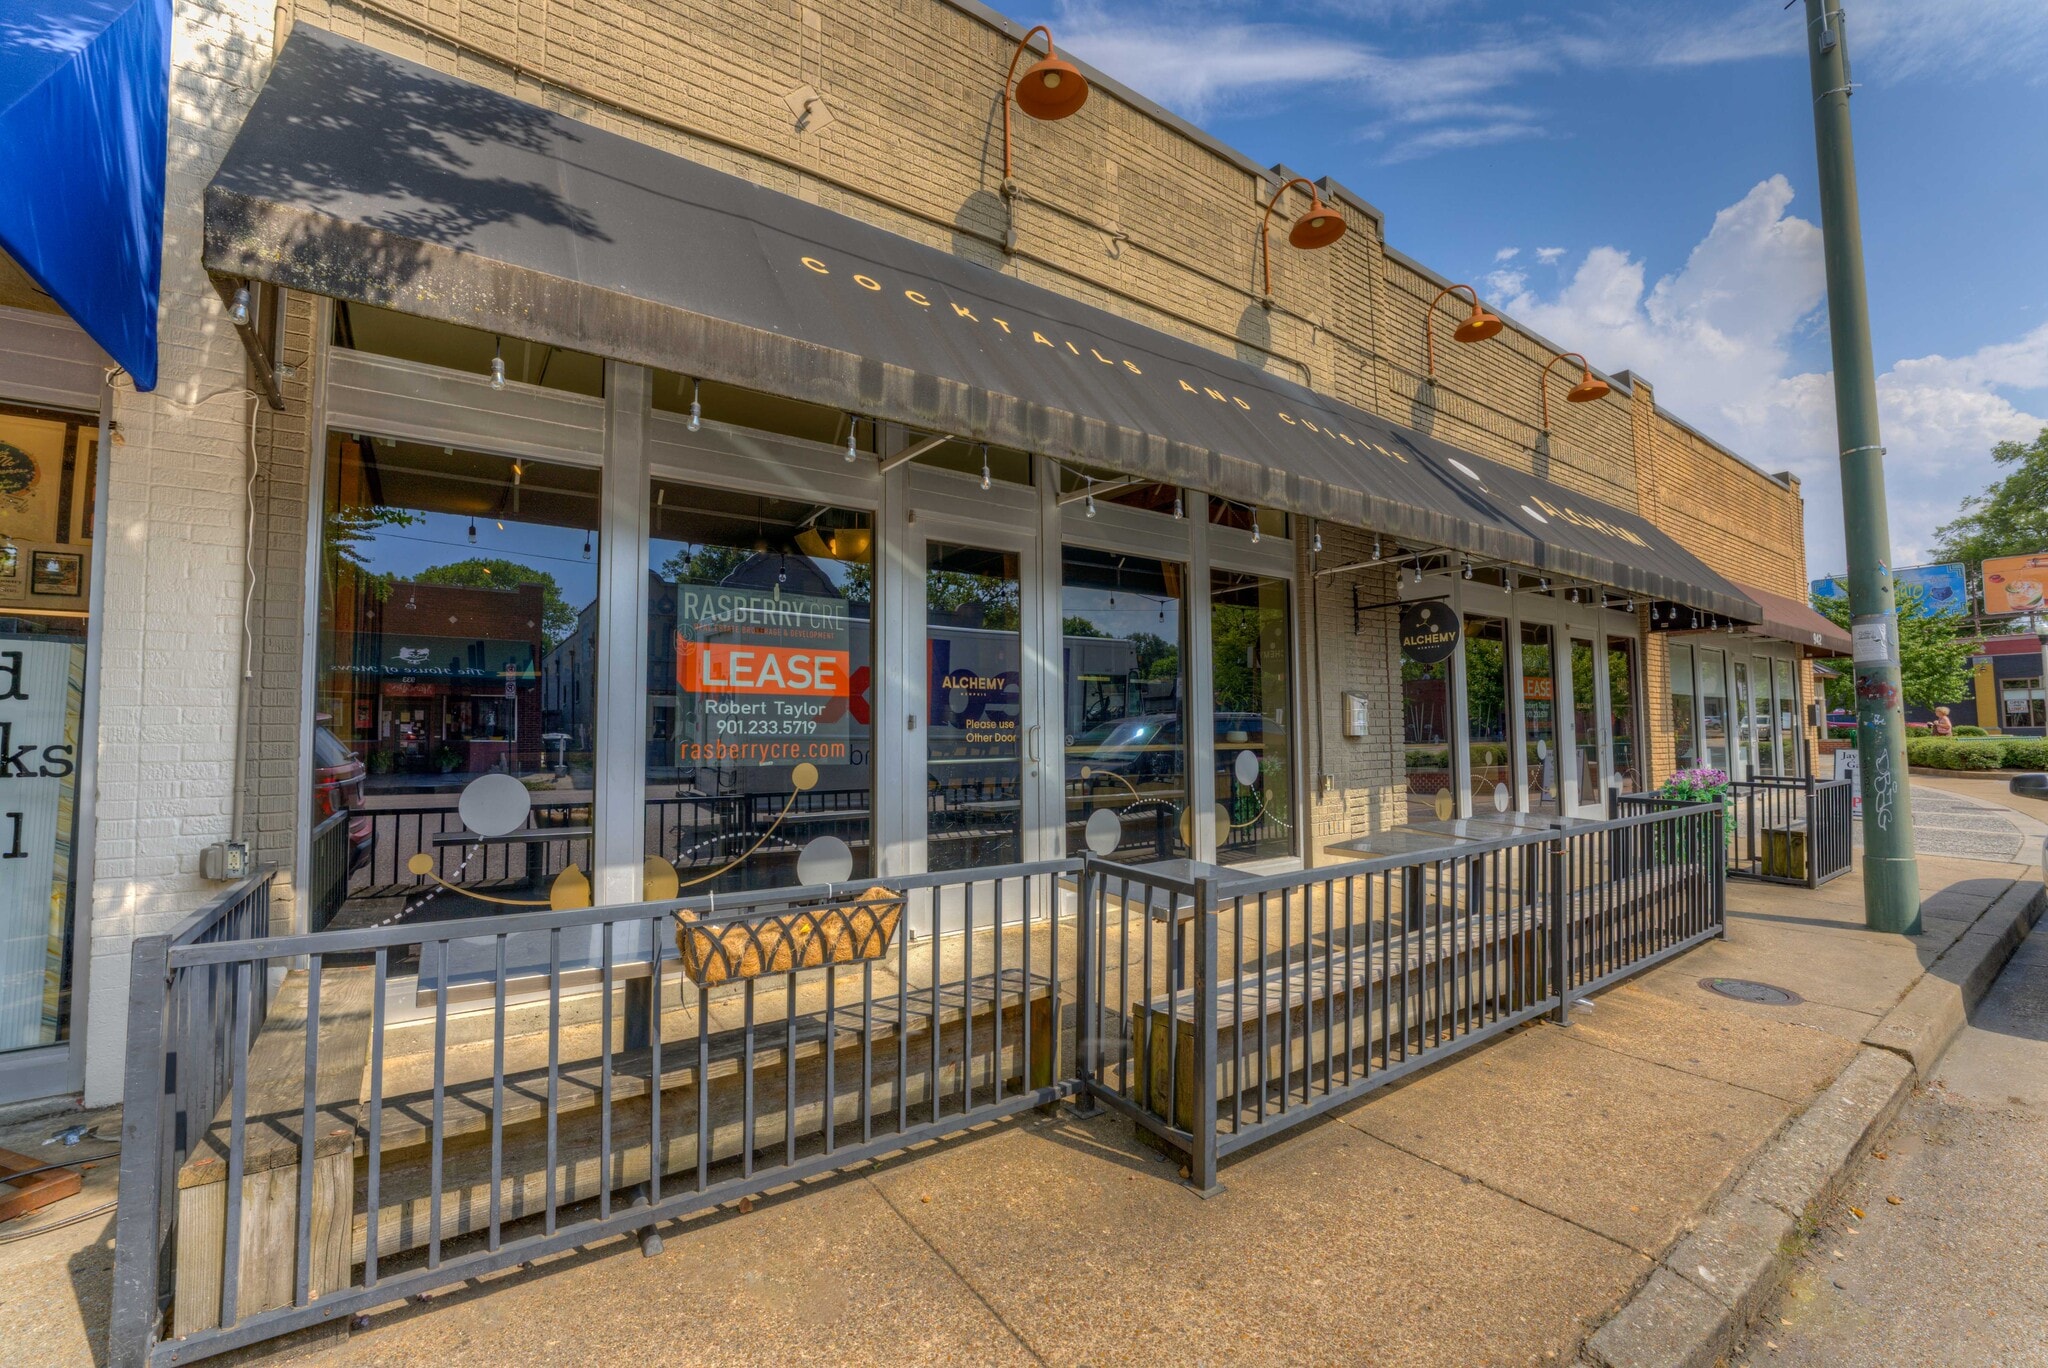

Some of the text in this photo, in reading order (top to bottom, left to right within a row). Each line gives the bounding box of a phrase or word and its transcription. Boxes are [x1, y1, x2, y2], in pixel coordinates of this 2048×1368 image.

[801, 256, 1409, 463] COCKTAILS AND CUISINE
[683, 591, 845, 631] RASBERRY CRE
[791, 630, 834, 640] DEVELOPMENT
[1403, 632, 1457, 646] ALCHEMY
[1812, 633, 1823, 646] 942
[703, 650, 837, 690] LEASE
[942, 675, 1005, 690] ALCHEMY
[705, 699, 827, 718] Robert Taylor
[716, 719, 817, 735] 901.233.5719
[966, 719, 1015, 729] Please use
[966, 732, 1017, 743] Other Door
[681, 738, 846, 763] rasberrycre.com
